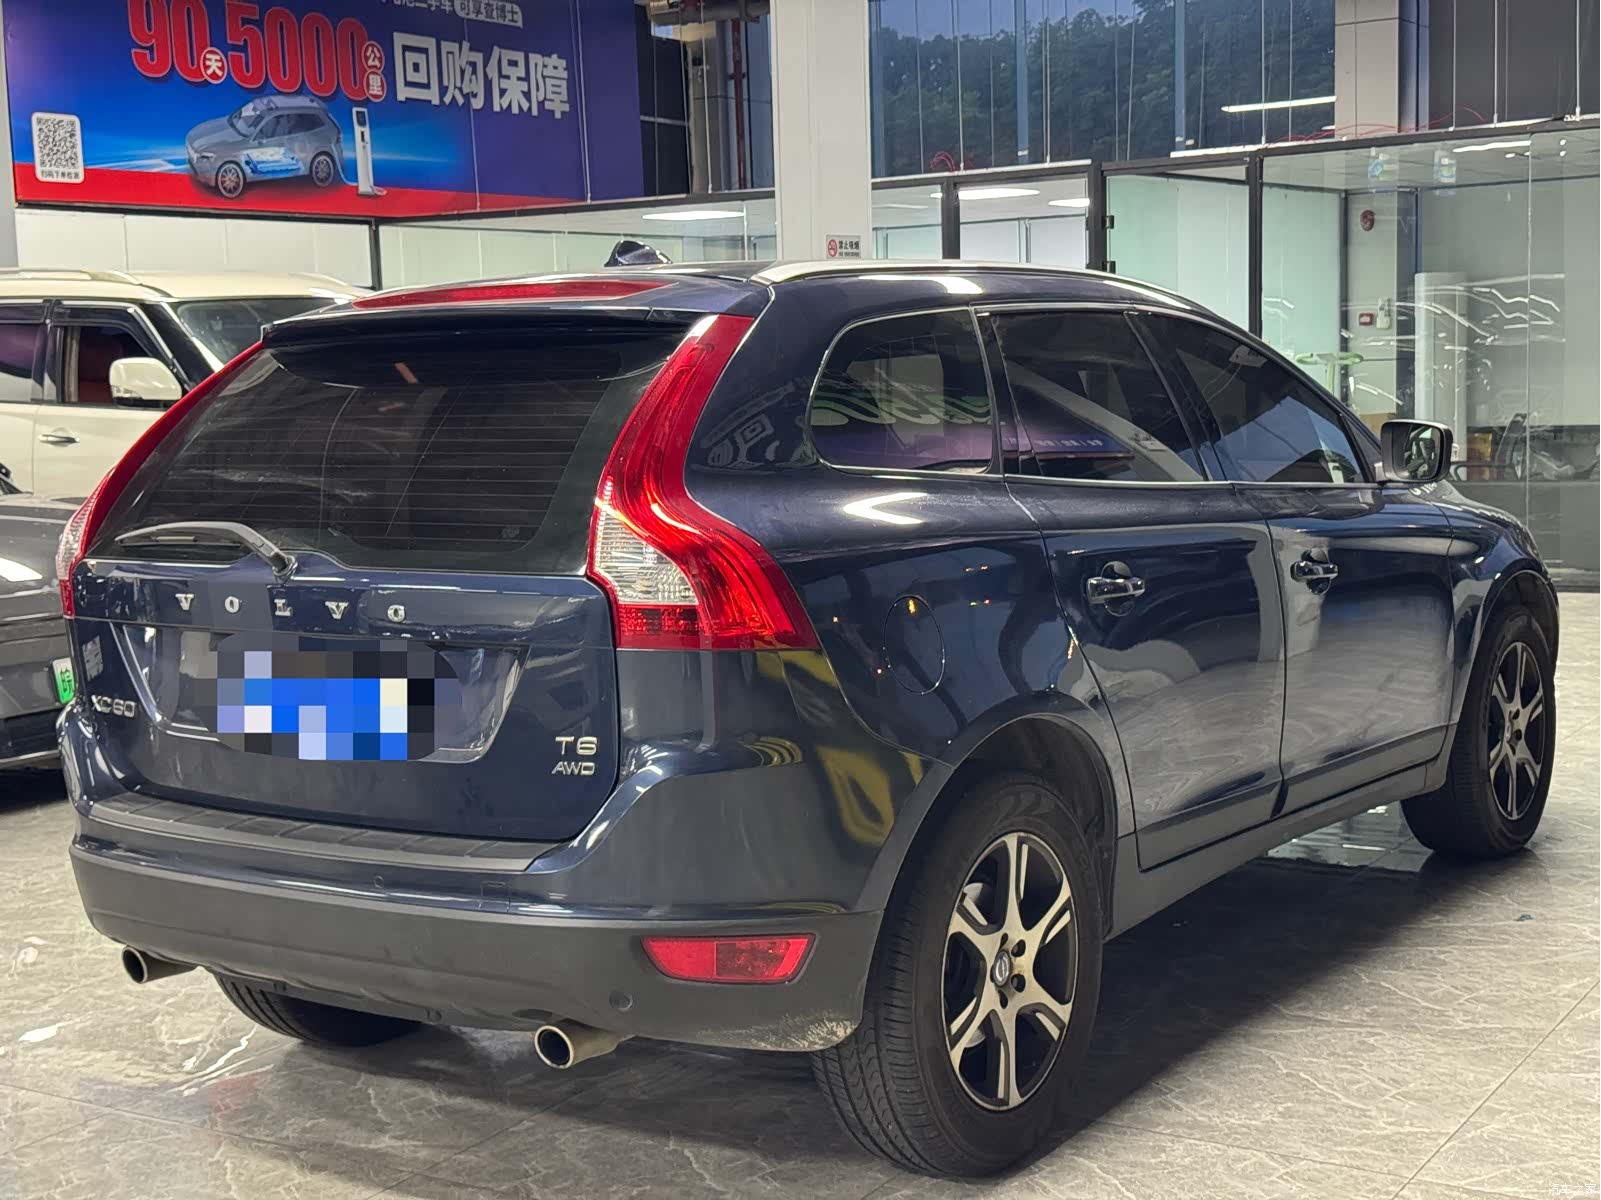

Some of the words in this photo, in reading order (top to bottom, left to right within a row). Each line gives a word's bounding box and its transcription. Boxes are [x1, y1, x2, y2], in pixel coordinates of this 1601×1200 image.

[225, 0, 370, 102] 5000
[393, 31, 570, 119] 回购保障
[175, 593, 406, 623] VOLVO
[91, 694, 136, 718] XC60
[555, 736, 598, 756] T6
[551, 761, 596, 776] AWD
